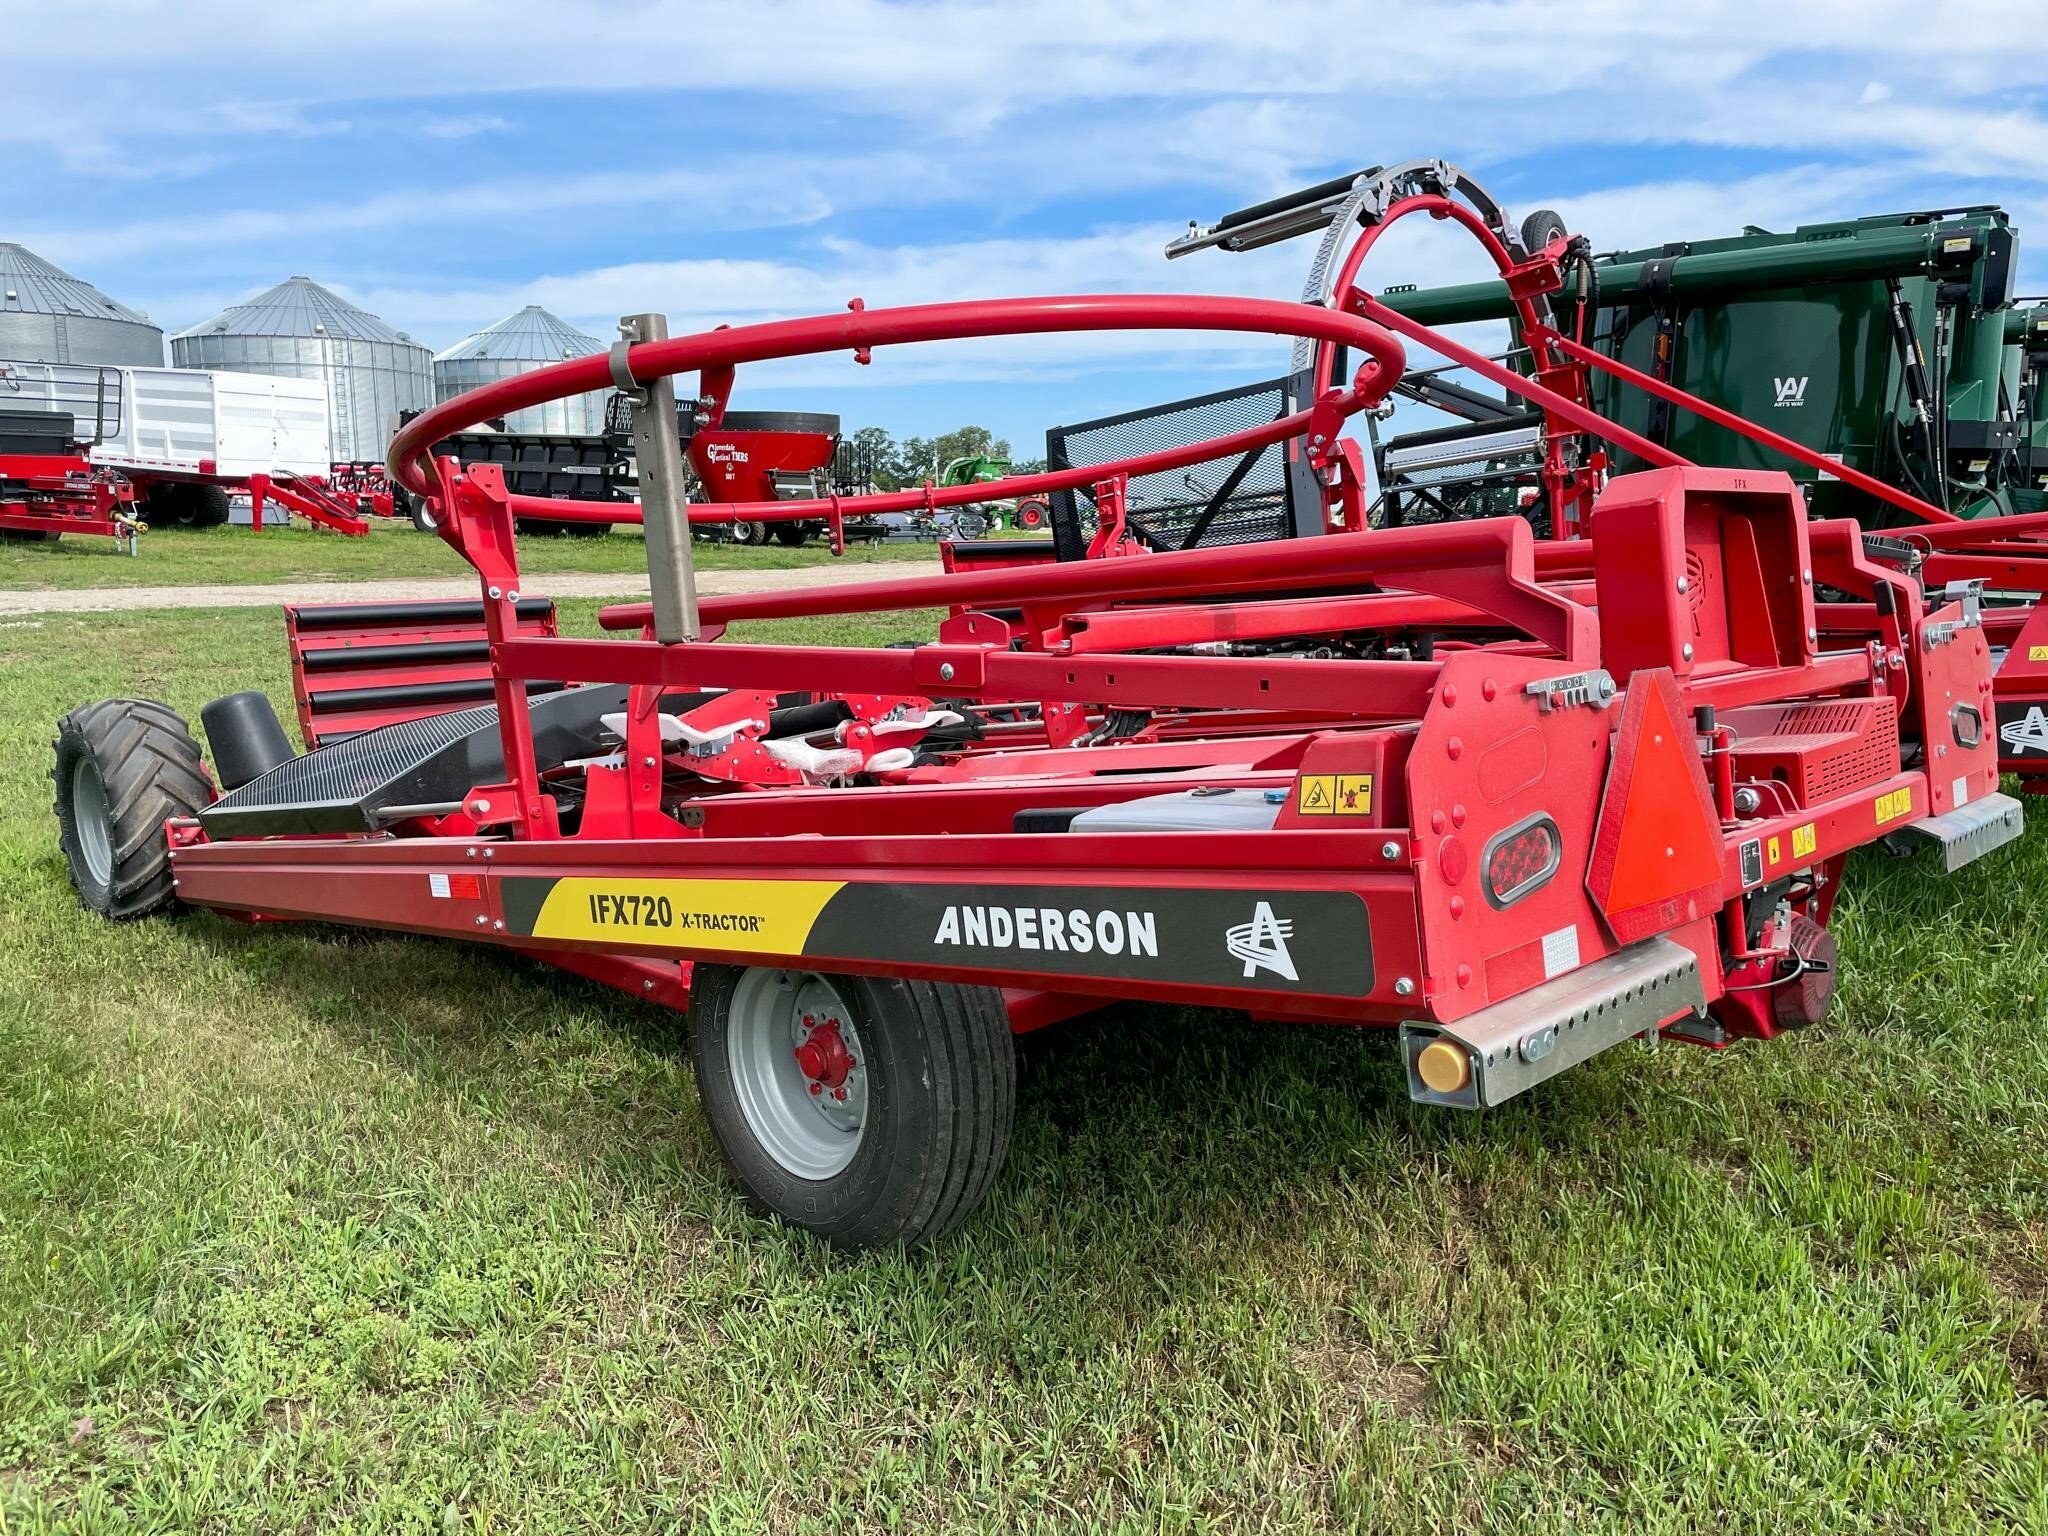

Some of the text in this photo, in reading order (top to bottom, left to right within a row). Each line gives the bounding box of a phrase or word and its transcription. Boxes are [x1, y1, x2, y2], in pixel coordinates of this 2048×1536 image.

[1735, 479, 1746, 488] IFX
[589, 894, 673, 928] IFX720
[933, 906, 1159, 957] ANDERSON
